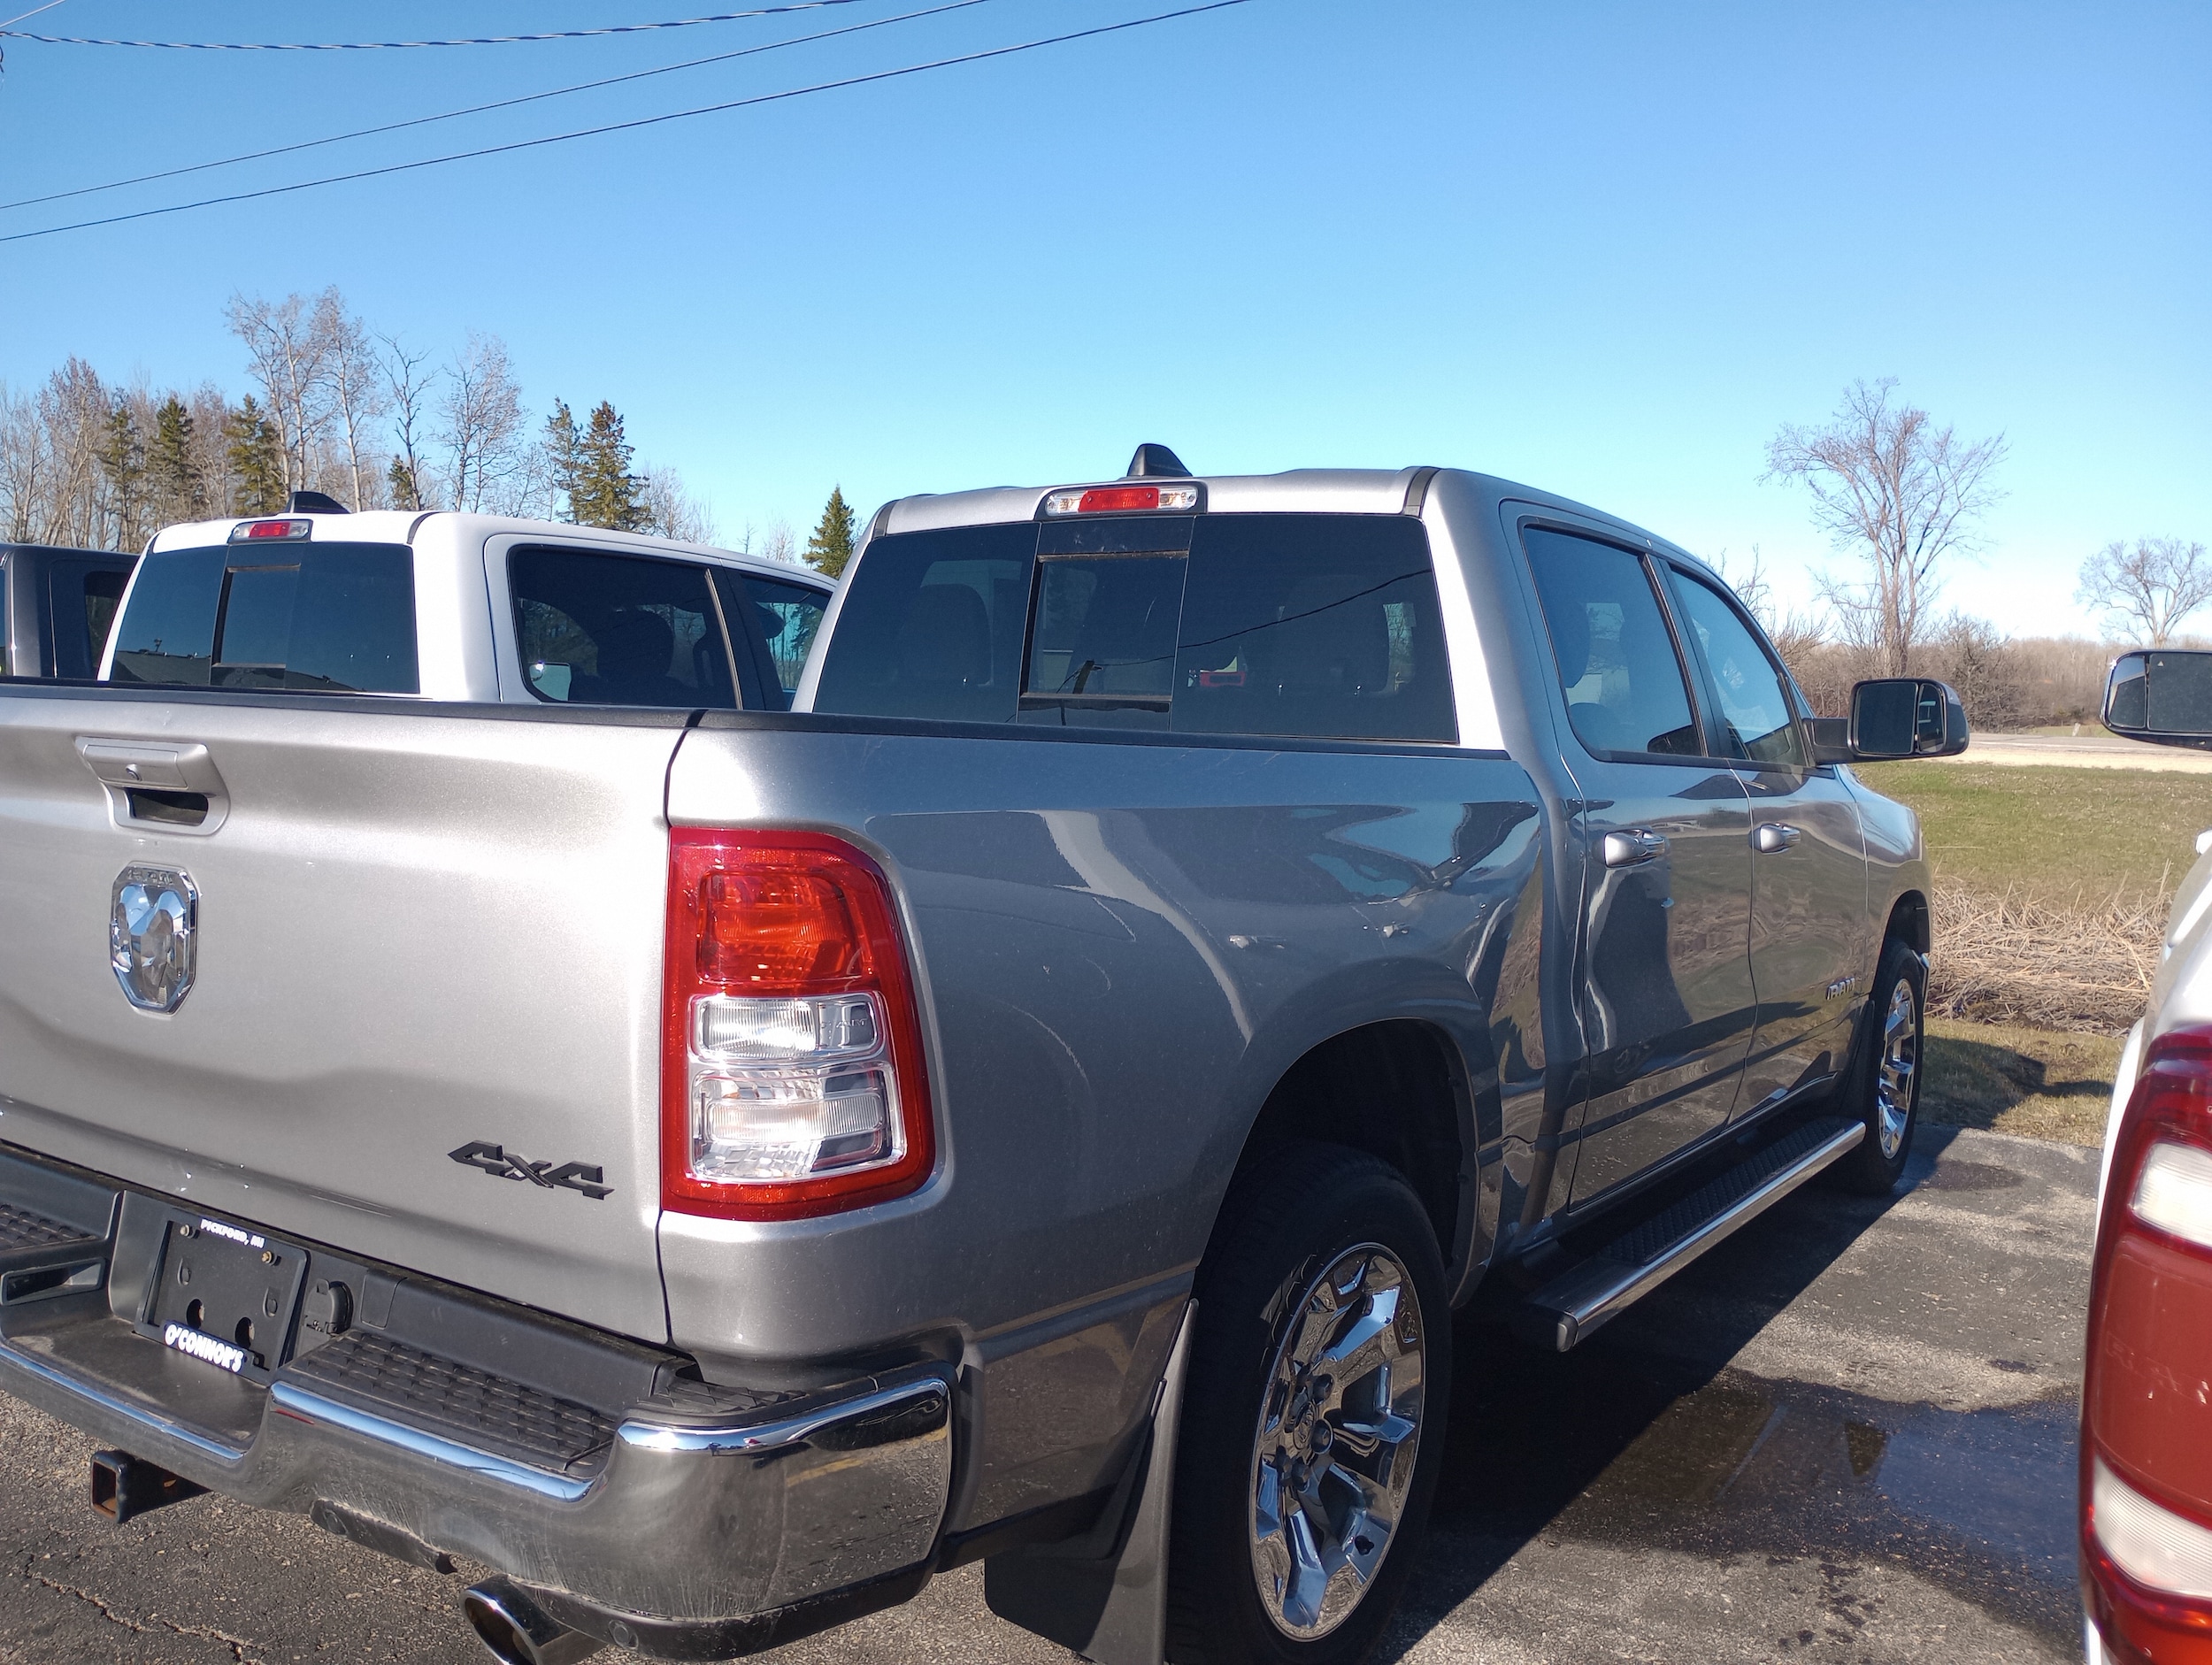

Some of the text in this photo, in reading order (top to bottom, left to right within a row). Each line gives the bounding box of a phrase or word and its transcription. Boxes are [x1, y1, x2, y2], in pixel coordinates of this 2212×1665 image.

[1826, 977, 1855, 1001] RAM
[200, 1218, 265, 1248] PICKFORD, MI
[165, 1324, 244, 1372] O'CONNOR'S
